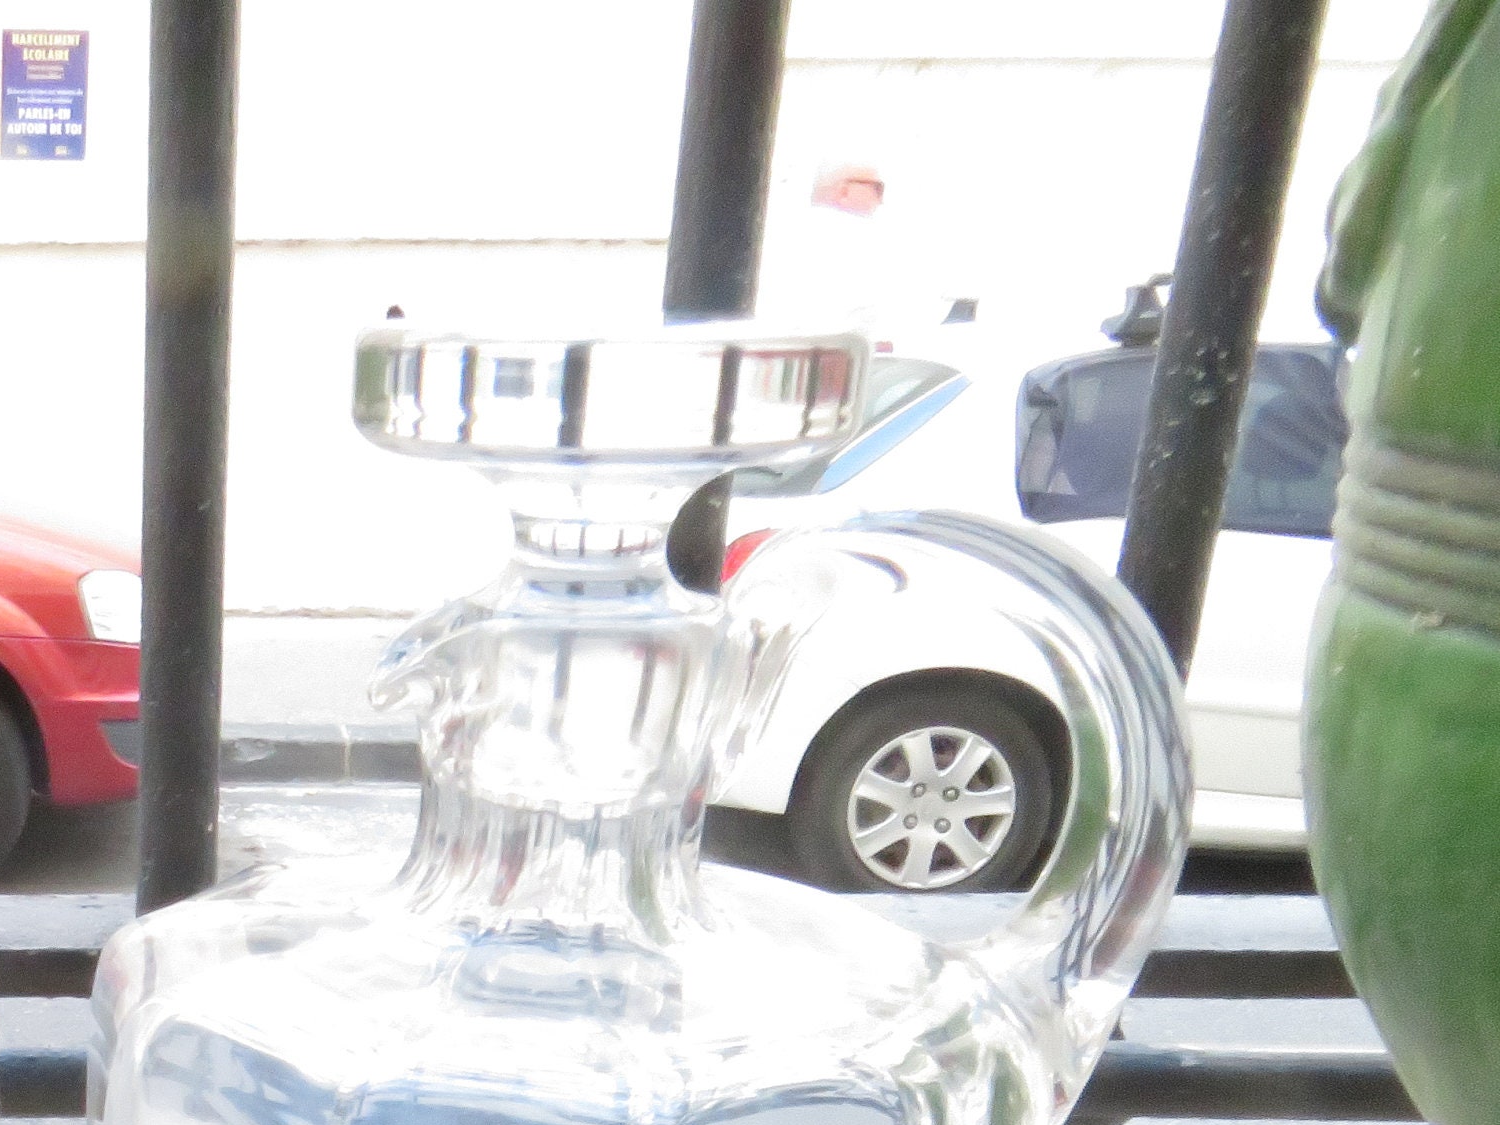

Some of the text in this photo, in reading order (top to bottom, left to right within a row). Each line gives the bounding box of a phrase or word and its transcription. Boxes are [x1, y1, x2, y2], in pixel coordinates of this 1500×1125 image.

[23, 48, 69, 61] SCOLAIRE
[18, 107, 71, 121] PARLES-EN
[7, 122, 82, 136] AUTOUR DE TOI
